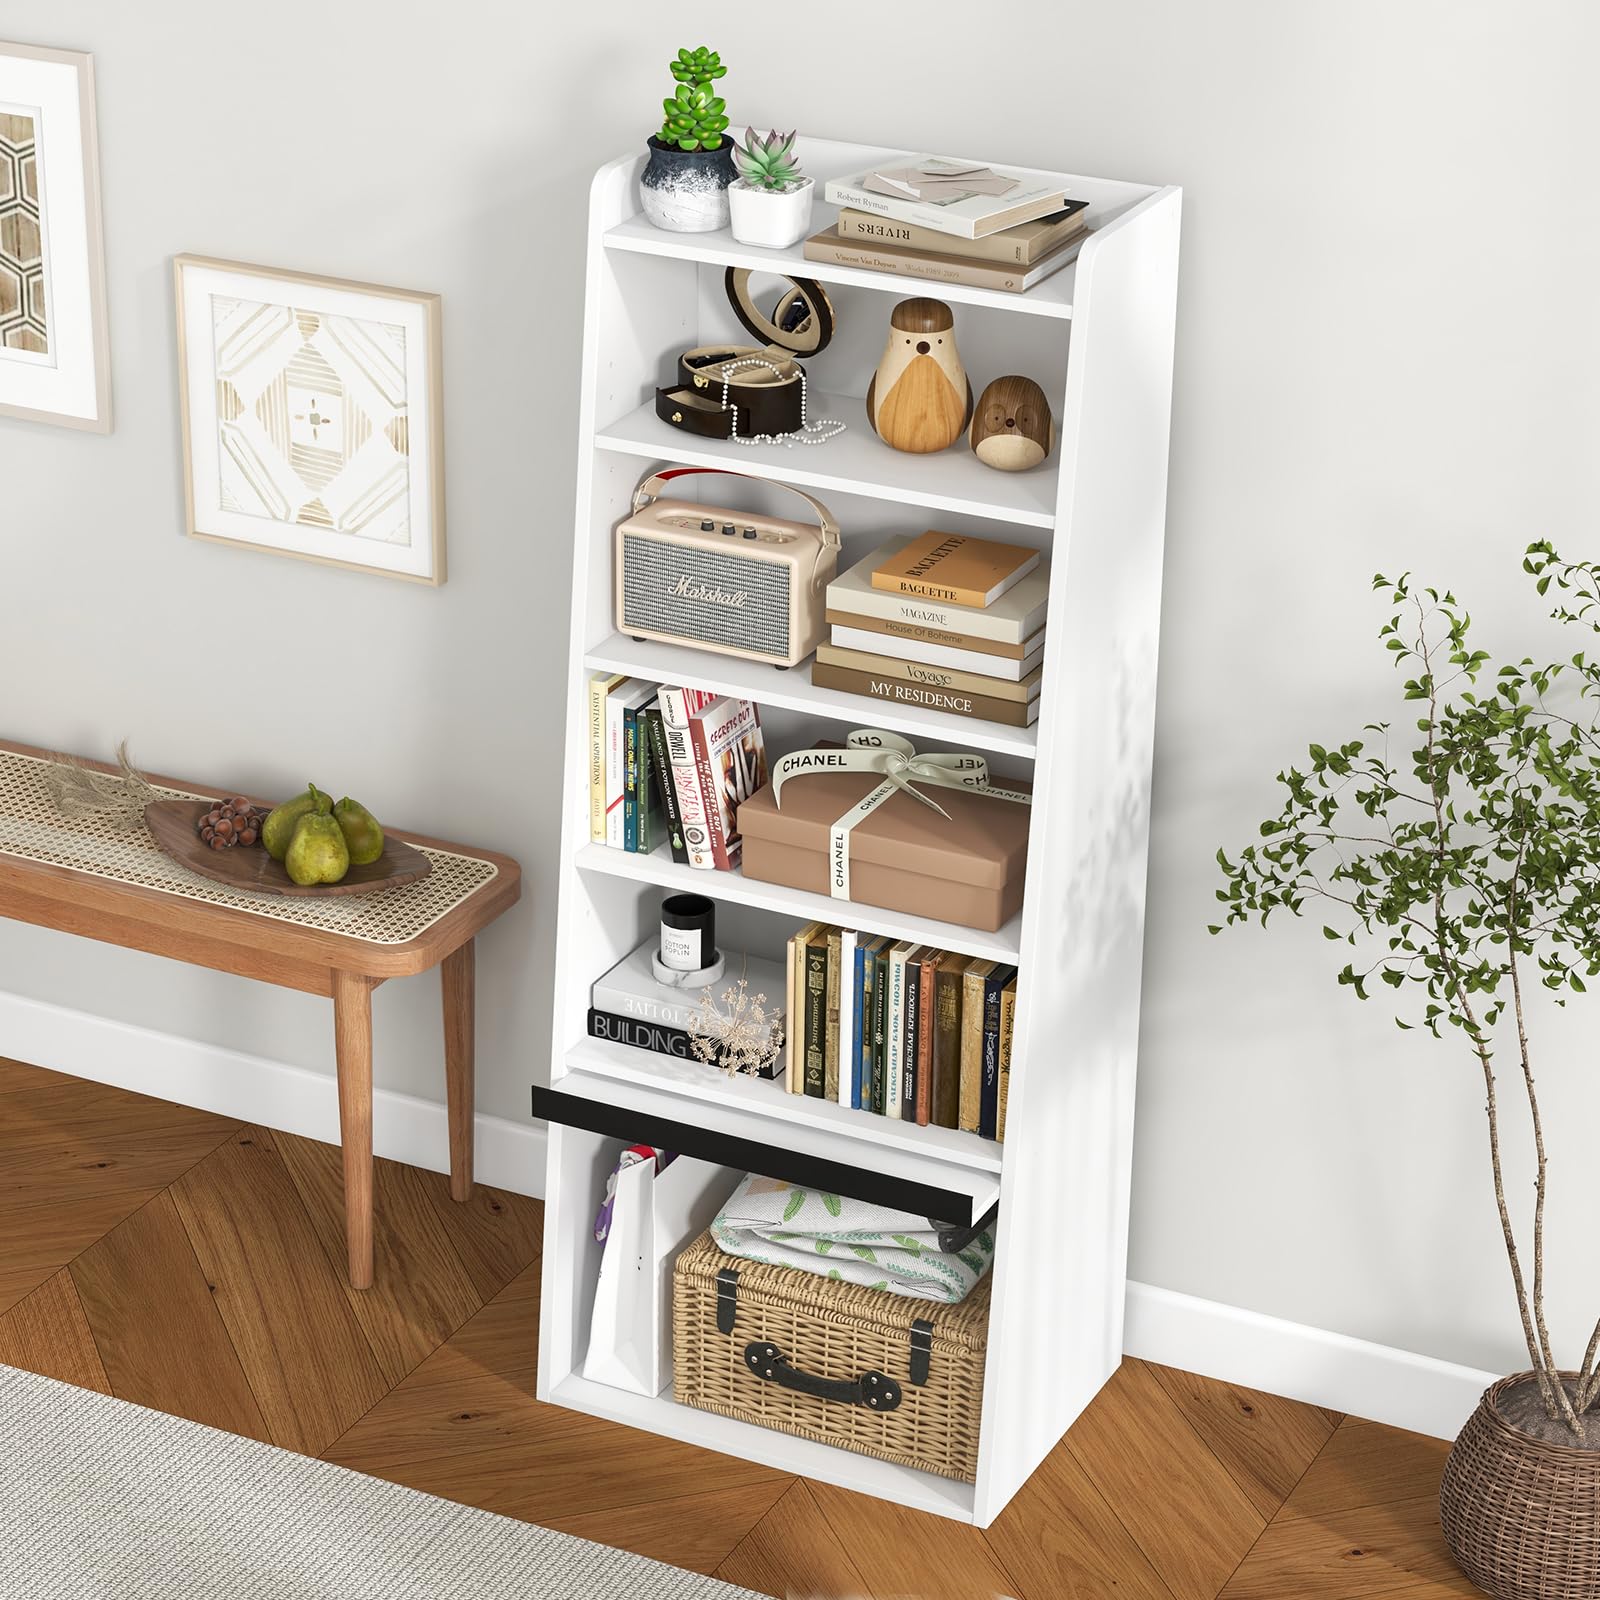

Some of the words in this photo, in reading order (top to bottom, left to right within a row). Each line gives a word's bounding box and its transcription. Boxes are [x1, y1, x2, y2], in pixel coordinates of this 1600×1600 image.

[836, 191, 861, 204] Robert
[862, 198, 889, 211] Ryman
[857, 223, 910, 240] RIVERS
[835, 253, 860, 262] Vincent
[860, 256, 873, 265] Van
[906, 537, 967, 577] BAGUETTE
[668, 574, 748, 607] Marshall
[900, 582, 957, 601] BAGUETTE
[901, 607, 948, 626] MAGAZINE
[885, 622, 912, 635] House
[914, 626, 926, 637] Of
[927, 630, 963, 645] Boheme
[907, 665, 952, 686] Voyage
[870, 681, 893, 697] MY
[895, 685, 972, 713] RESIDENCE
[592, 692, 600, 740] EXISTENTIAL
[710, 717, 737, 745] SECRETS
[738, 707, 750, 723] OUT
[668, 731, 687, 760] ORWELL
[592, 742, 600, 785] ASPIRATIONS
[627, 750, 635, 772] ONLINE
[703, 760, 711, 776] THE
[783, 755, 847, 773] CHANEL
[627, 773, 635, 791] NEWS
[661, 767, 671, 795] POTION
[667, 796, 675, 819] MAKER
[706, 778, 718, 813] SECRETS
[978, 788, 1028, 800] CHANEL
[860, 784, 893, 811] CHANEL
[713, 816, 721, 831] OUT
[836, 833, 844, 887] CHANEL
[665, 939, 690, 950] COTTON
[665, 945, 690, 956] POPLIN
[893, 963, 901, 1006] ПОЭМЫ
[624, 998, 657, 1018] LIVE
[661, 1007, 680, 1025] TO
[907, 984, 916, 1031] КРЕПОСТЬ
[1003, 1000, 1014, 1035] жизни
[594, 1015, 686, 1056] BUILDING
[906, 1032, 914, 1070] ЛЕСНАЯ
[1001, 1036, 1010, 1074] Жажда
[890, 1045, 898, 1105] АЛЕКСАНДР
